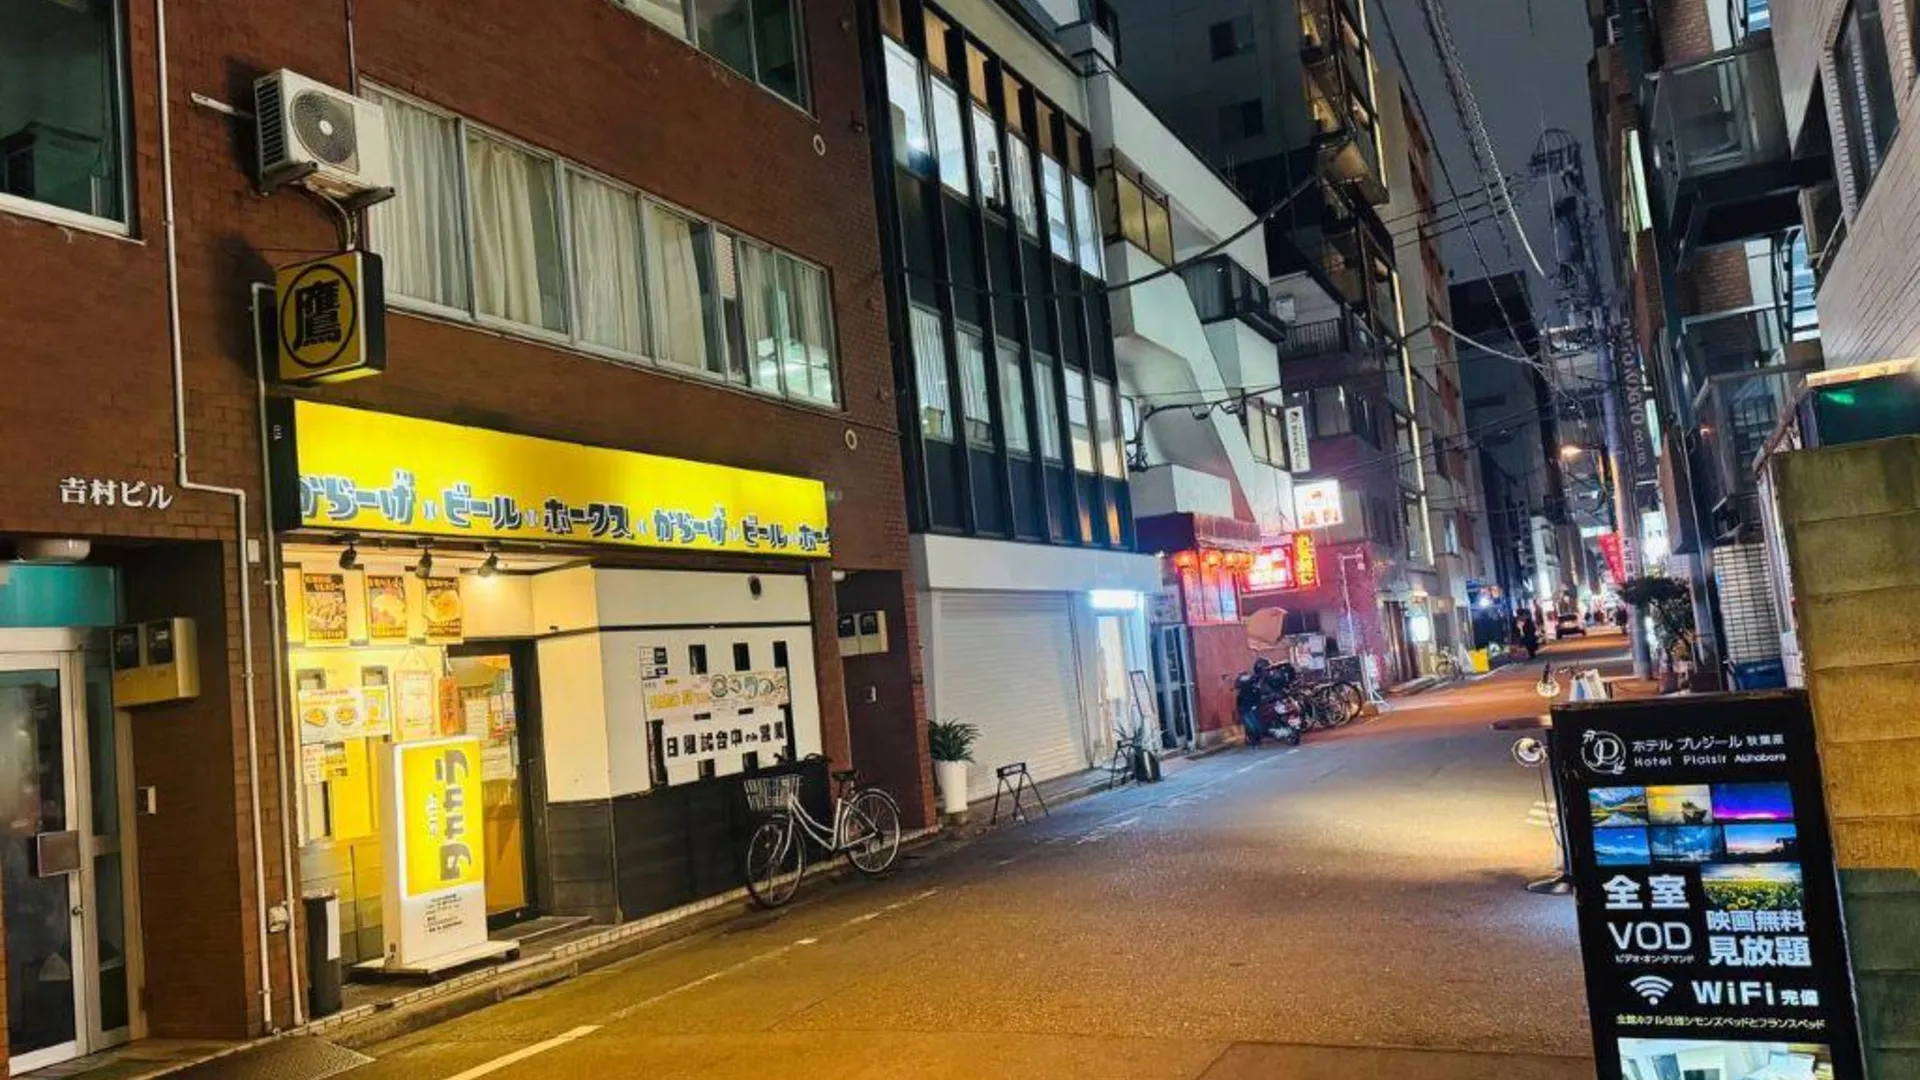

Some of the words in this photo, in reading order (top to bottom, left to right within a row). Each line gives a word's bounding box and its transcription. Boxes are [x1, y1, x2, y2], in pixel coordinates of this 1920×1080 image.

[292, 279, 342, 352] 鷹
[60, 477, 173, 510] 吉村ビル
[443, 481, 522, 529] ビール
[543, 497, 634, 539] ホークス
[653, 503, 728, 547] からーげ
[742, 511, 788, 548] ビール
[1632, 739, 1673, 752] ホテル
[1676, 735, 1743, 751] プレジール
[1746, 734, 1785, 747] 秋葉原
[1634, 756, 1672, 767] Hotel
[1683, 755, 1727, 765] Plaisir
[1602, 874, 1690, 910] 全室
[1607, 921, 1693, 951] VOD
[1706, 910, 1805, 933] 映画無料
[1708, 935, 1812, 967] 見放題
[1691, 981, 1774, 1006] WiFi
[1780, 989, 1820, 1006] 完備
